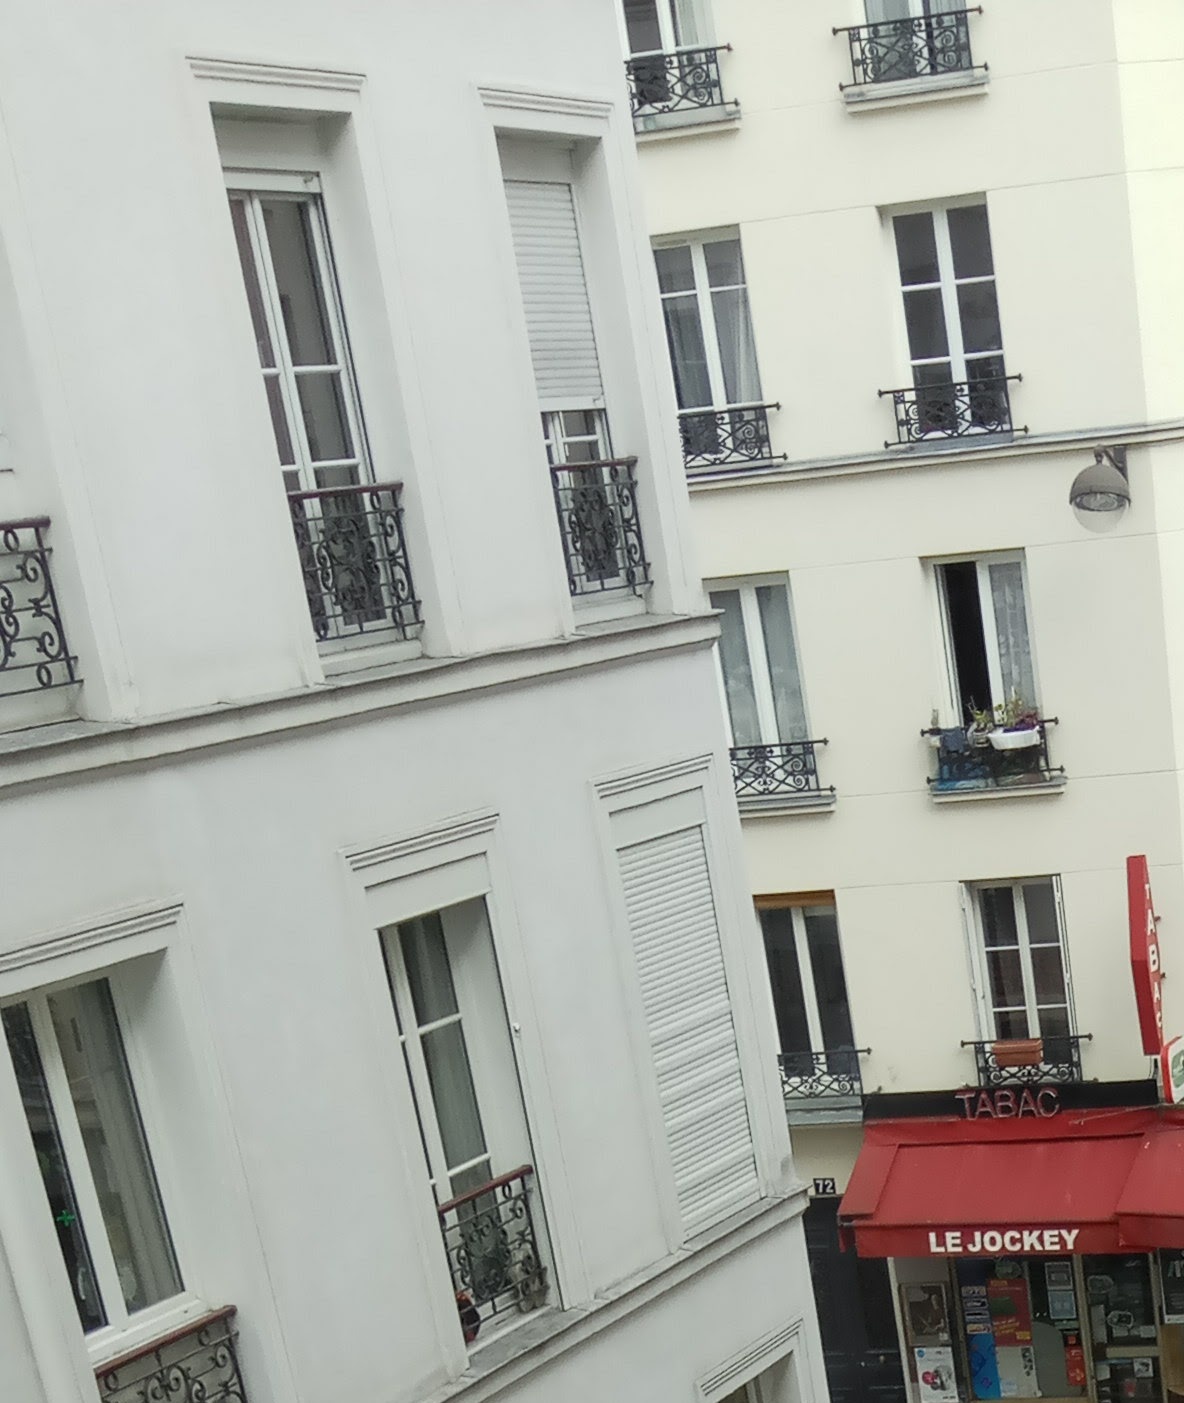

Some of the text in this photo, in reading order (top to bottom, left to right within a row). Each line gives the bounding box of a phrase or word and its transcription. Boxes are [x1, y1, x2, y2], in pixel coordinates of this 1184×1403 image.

[955, 1086, 1061, 1121] TABAC
[815, 1179, 834, 1193] 72
[928, 1228, 1080, 1253] LE JOCKEY
